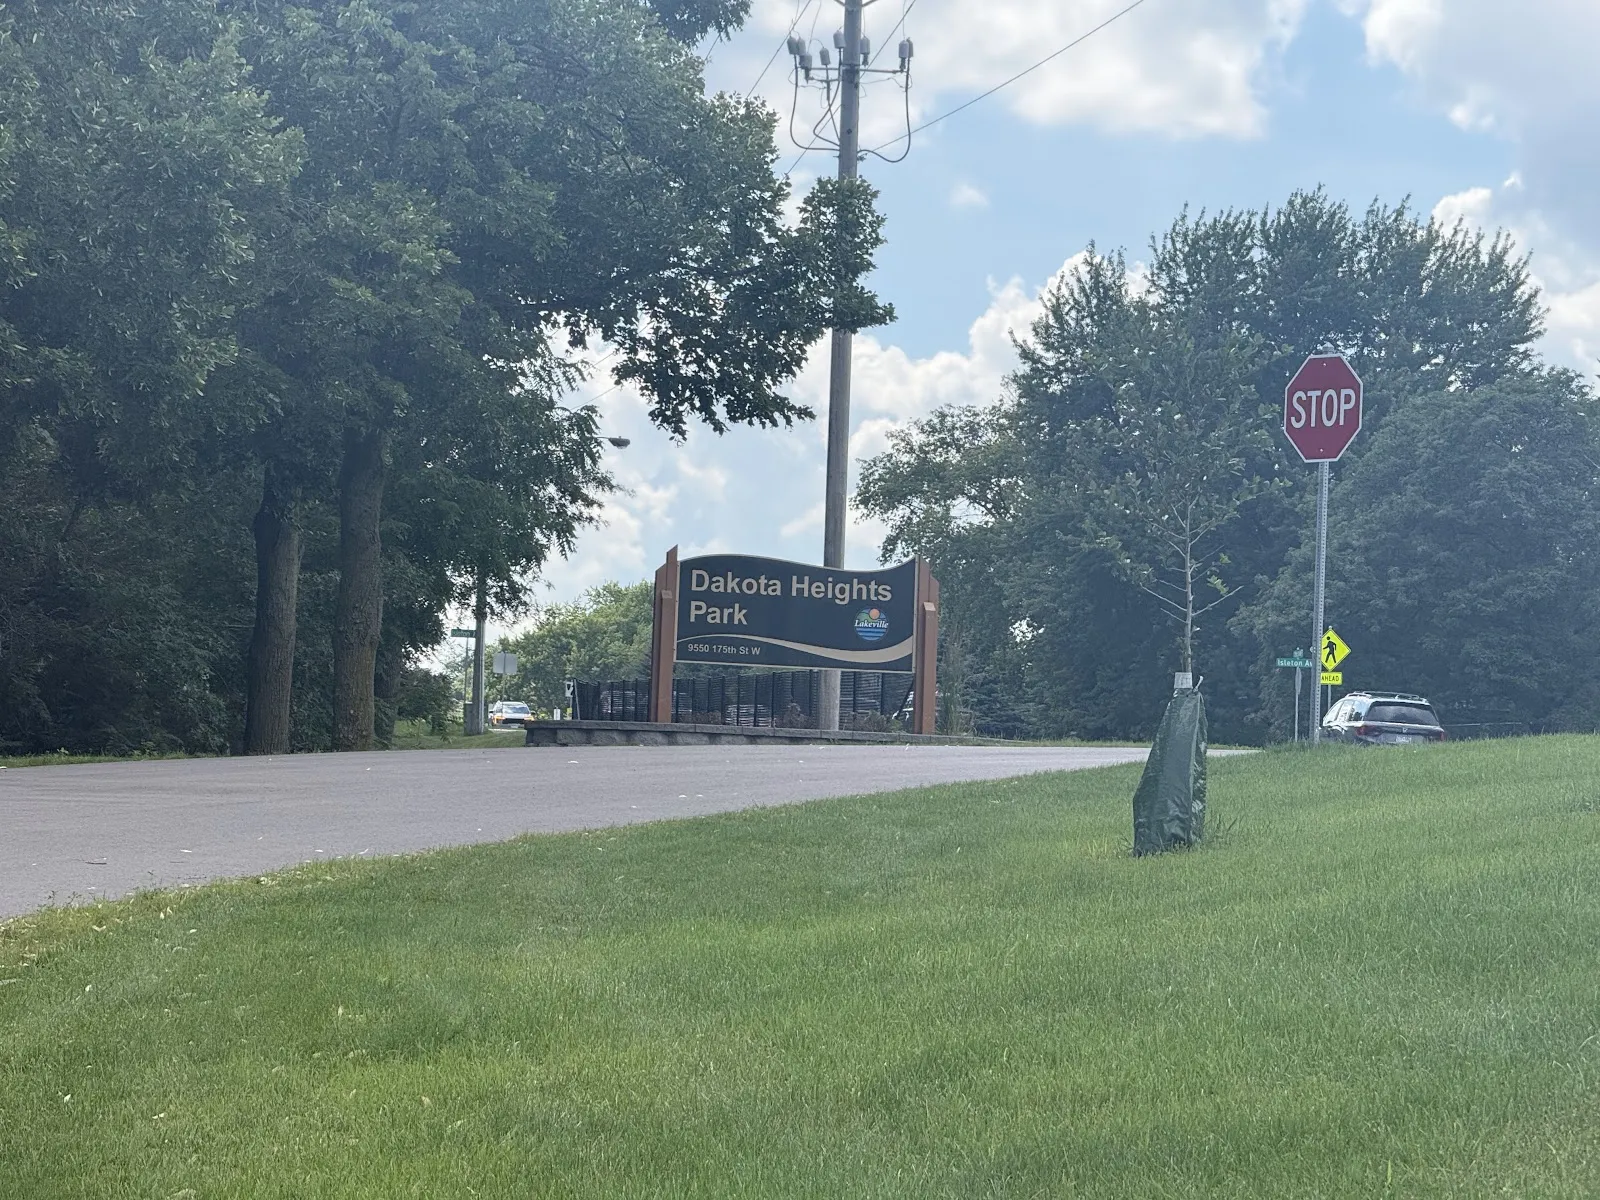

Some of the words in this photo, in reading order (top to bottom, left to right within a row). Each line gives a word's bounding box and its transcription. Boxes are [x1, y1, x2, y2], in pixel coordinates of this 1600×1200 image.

[1290, 388, 1356, 429] STOP
[690, 569, 782, 596] Dakota
[791, 575, 892, 605] Heights
[689, 600, 748, 625] Park
[854, 619, 889, 629] Lakeville
[687, 643, 710, 653] 9550
[712, 645, 737, 654] 175th
[739, 646, 749, 655] St
[751, 646, 761, 655] W
[1277, 659, 1303, 667] Isleton
